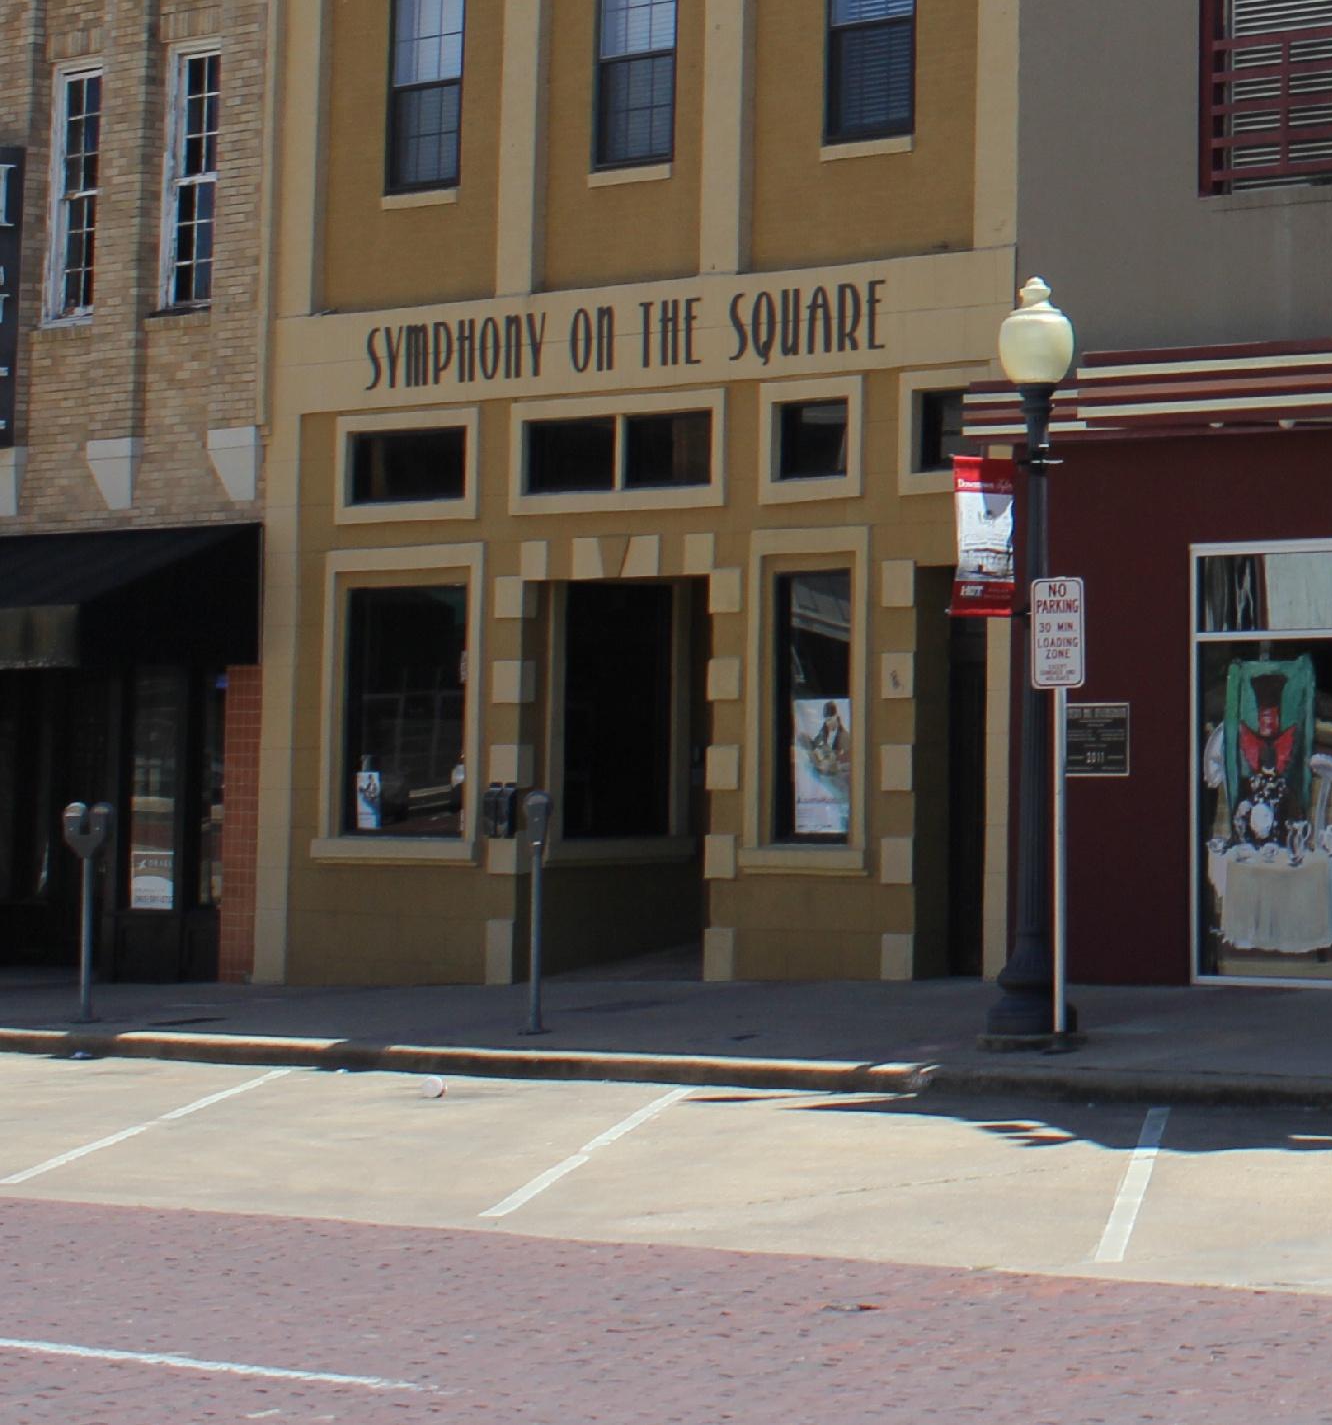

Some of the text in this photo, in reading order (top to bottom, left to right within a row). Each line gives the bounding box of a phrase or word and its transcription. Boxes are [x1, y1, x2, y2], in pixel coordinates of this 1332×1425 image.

[365, 279, 887, 391] SYMPHONY ON THE SQUARE
[1048, 583, 1067, 598] NO
[1036, 598, 1079, 614] PARKING
[1038, 622, 1051, 634] 30
[1037, 637, 1079, 648] LOADING
[1045, 648, 1071, 660] ZONE
